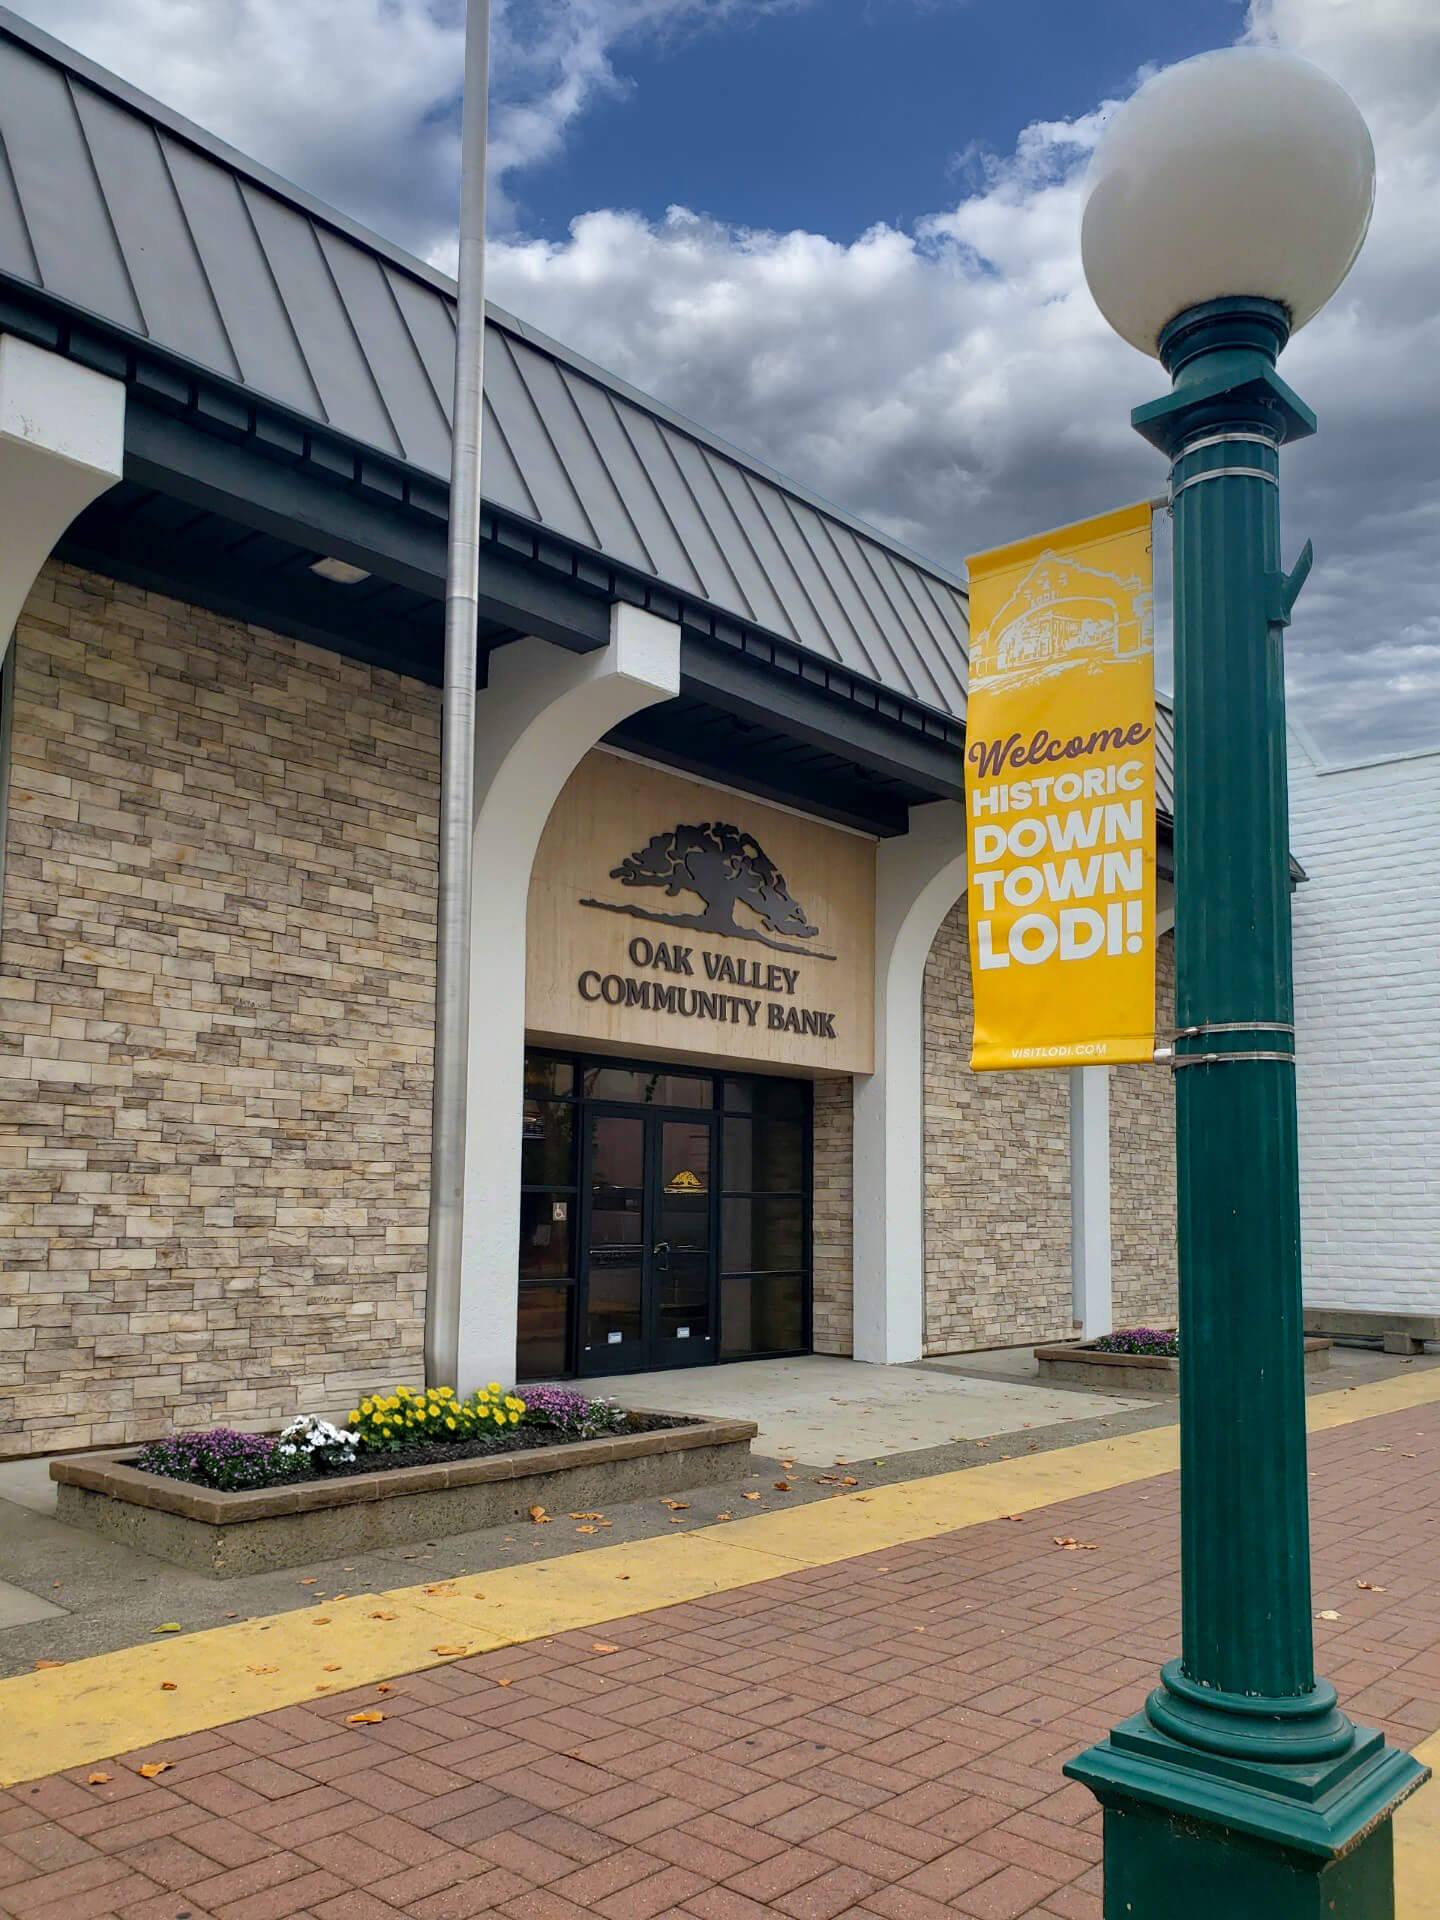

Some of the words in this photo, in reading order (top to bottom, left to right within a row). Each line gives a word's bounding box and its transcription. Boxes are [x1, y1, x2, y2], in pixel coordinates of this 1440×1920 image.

[968, 722, 1152, 778] Welcome
[972, 760, 1144, 817] HISTORIC
[974, 800, 1143, 865] DOWN
[973, 848, 1143, 911] TOWN
[977, 900, 1143, 970] LODI!
[629, 937, 694, 976] OAK
[702, 951, 800, 995] VALLEY
[578, 970, 761, 1027] COMMUNITY
[767, 1002, 837, 1039] BANK
[1011, 1043, 1107, 1058] VISITLODI.COM
